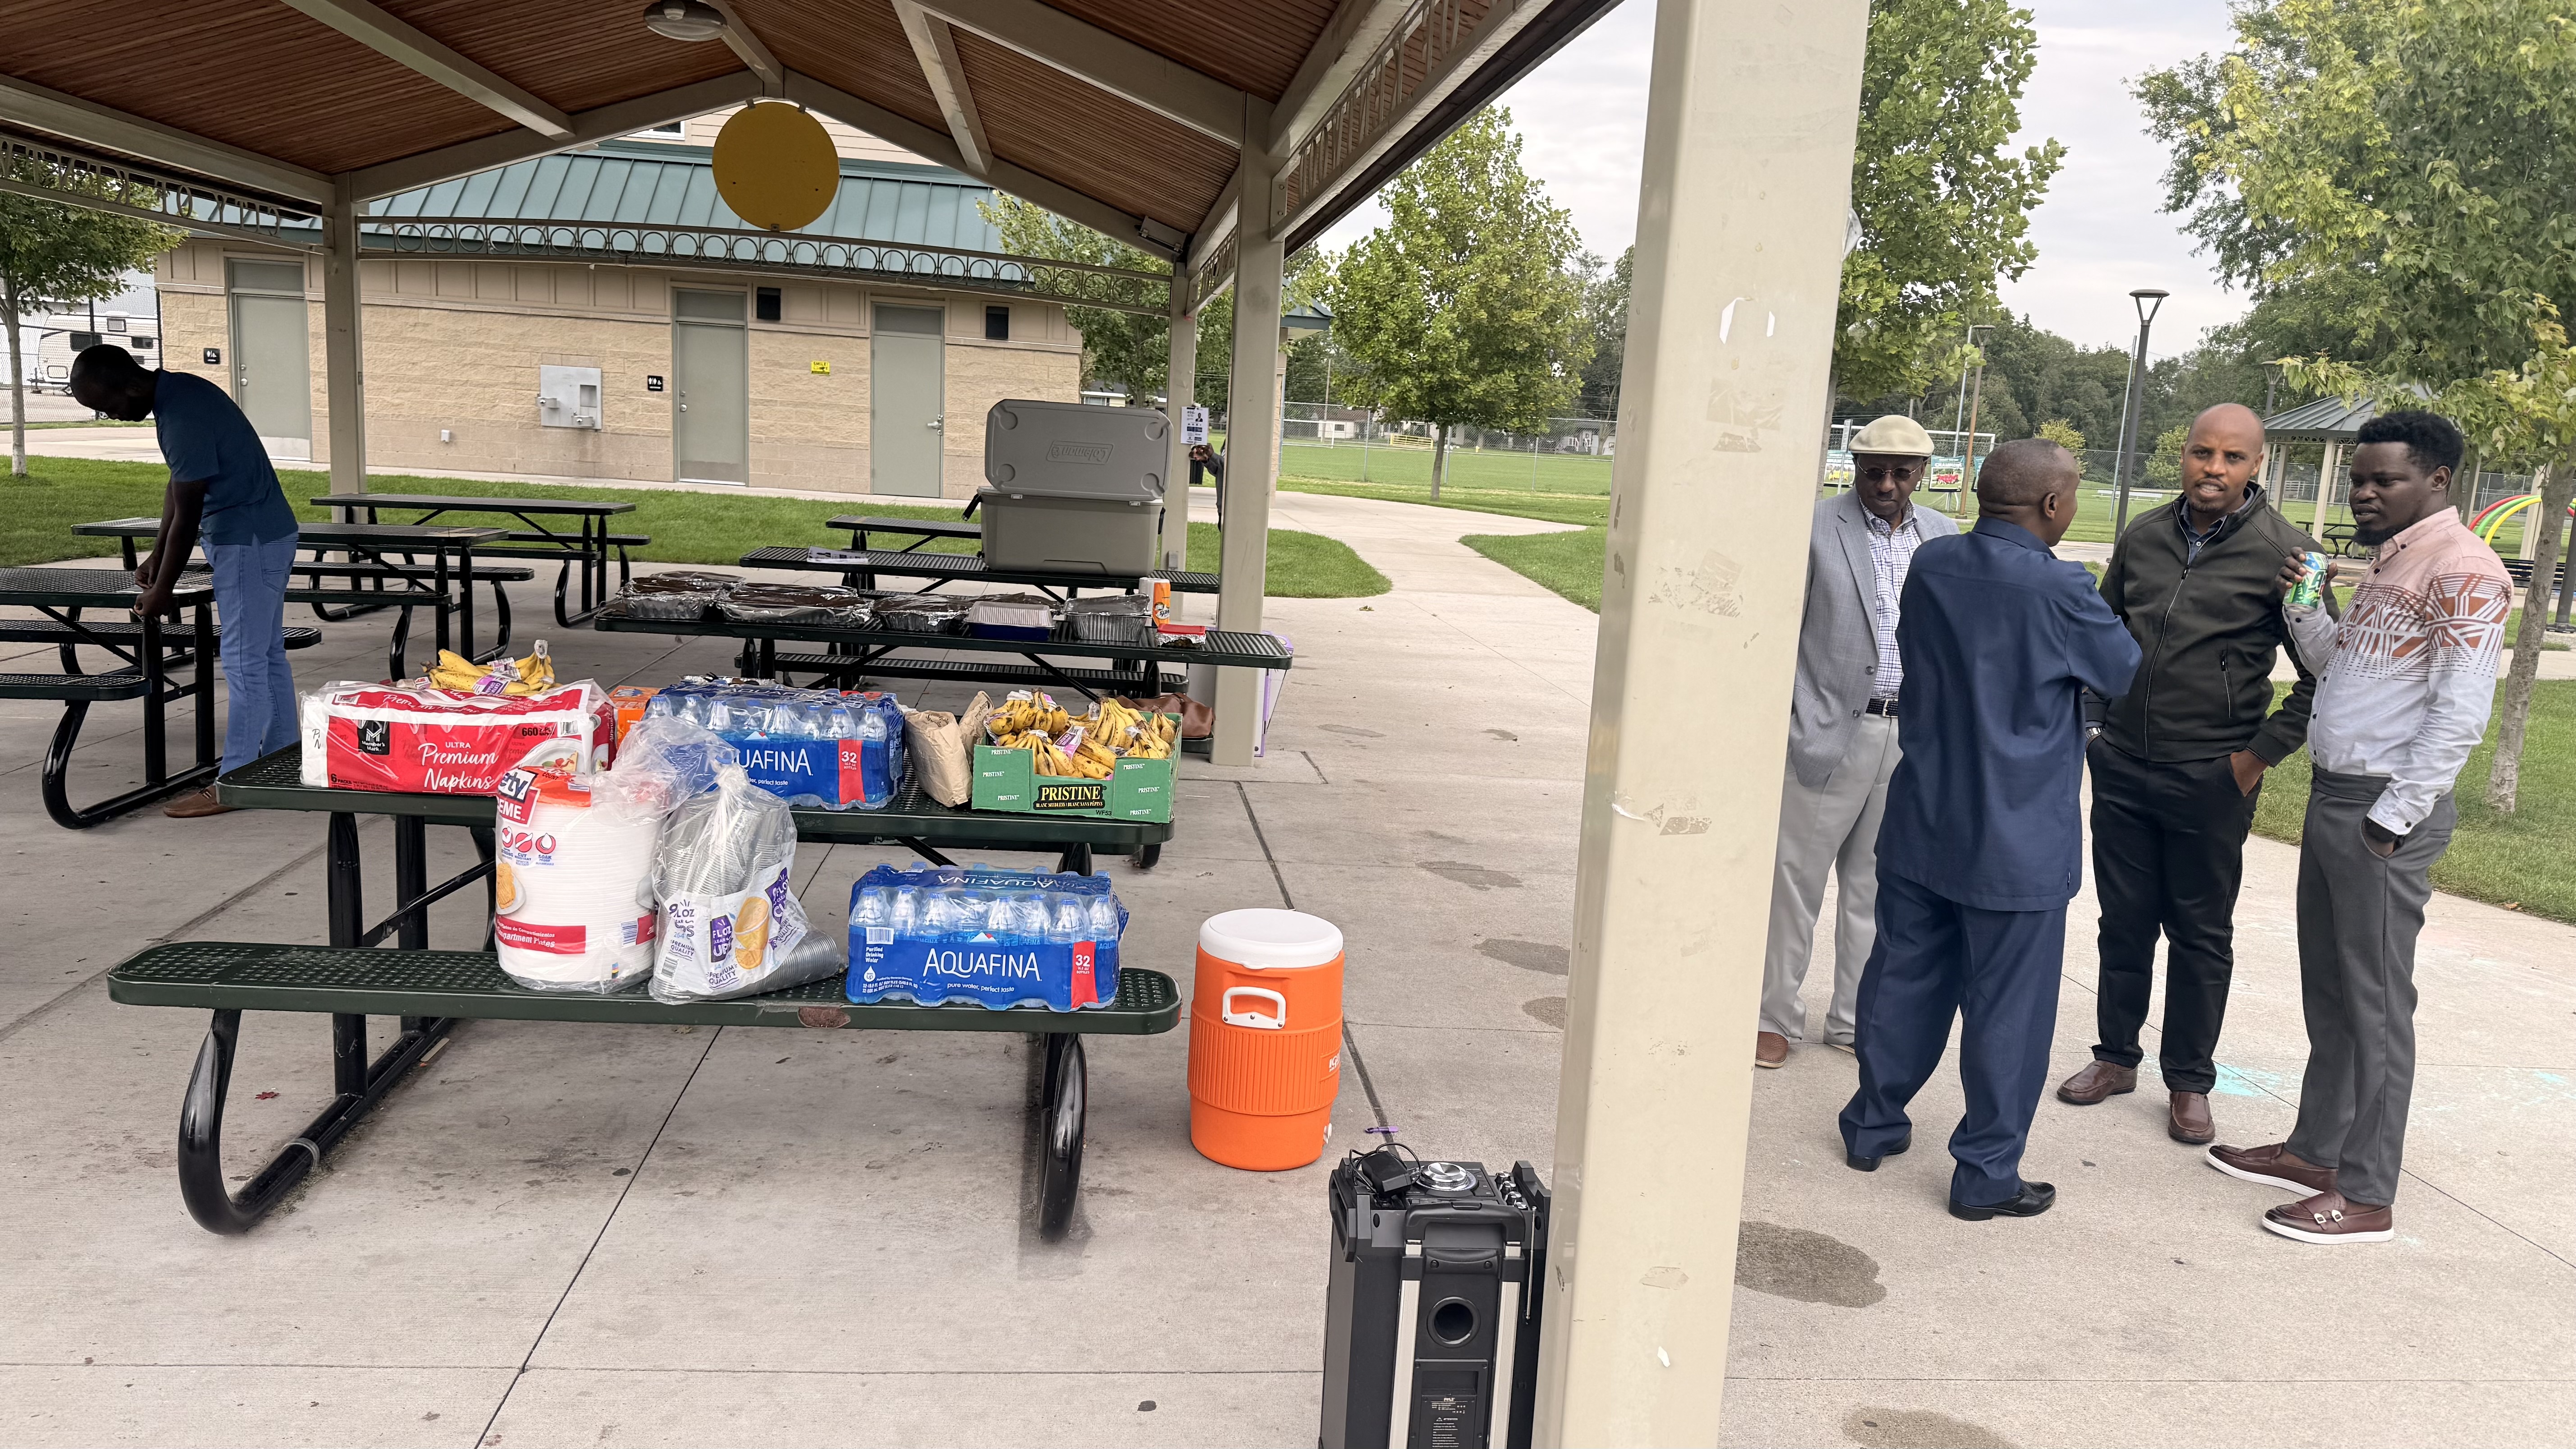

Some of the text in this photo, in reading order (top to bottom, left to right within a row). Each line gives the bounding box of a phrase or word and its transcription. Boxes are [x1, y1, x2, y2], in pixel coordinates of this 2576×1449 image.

[1062, 447, 1106, 463] Coleman
[729, 688, 815, 698] AQUAFIN
[522, 727, 538, 736] 660
[418, 743, 499, 766] Premium
[841, 751, 857, 764] 32
[736, 748, 812, 776] UAFINA
[331, 774, 337, 783] 6
[423, 768, 495, 792] Napkins
[1041, 787, 1100, 801] PRISTINE
[498, 799, 522, 820] EME
[938, 875, 1054, 888] AQUAFINA
[669, 903, 678, 915] 9
[682, 909, 695, 917] OZ
[534, 937, 556, 948] Plates
[671, 945, 694, 956] QUALITY
[923, 948, 1041, 981] AQUAFINA
[1076, 954, 1090, 967] 32
[709, 970, 736, 985] QUALITY
